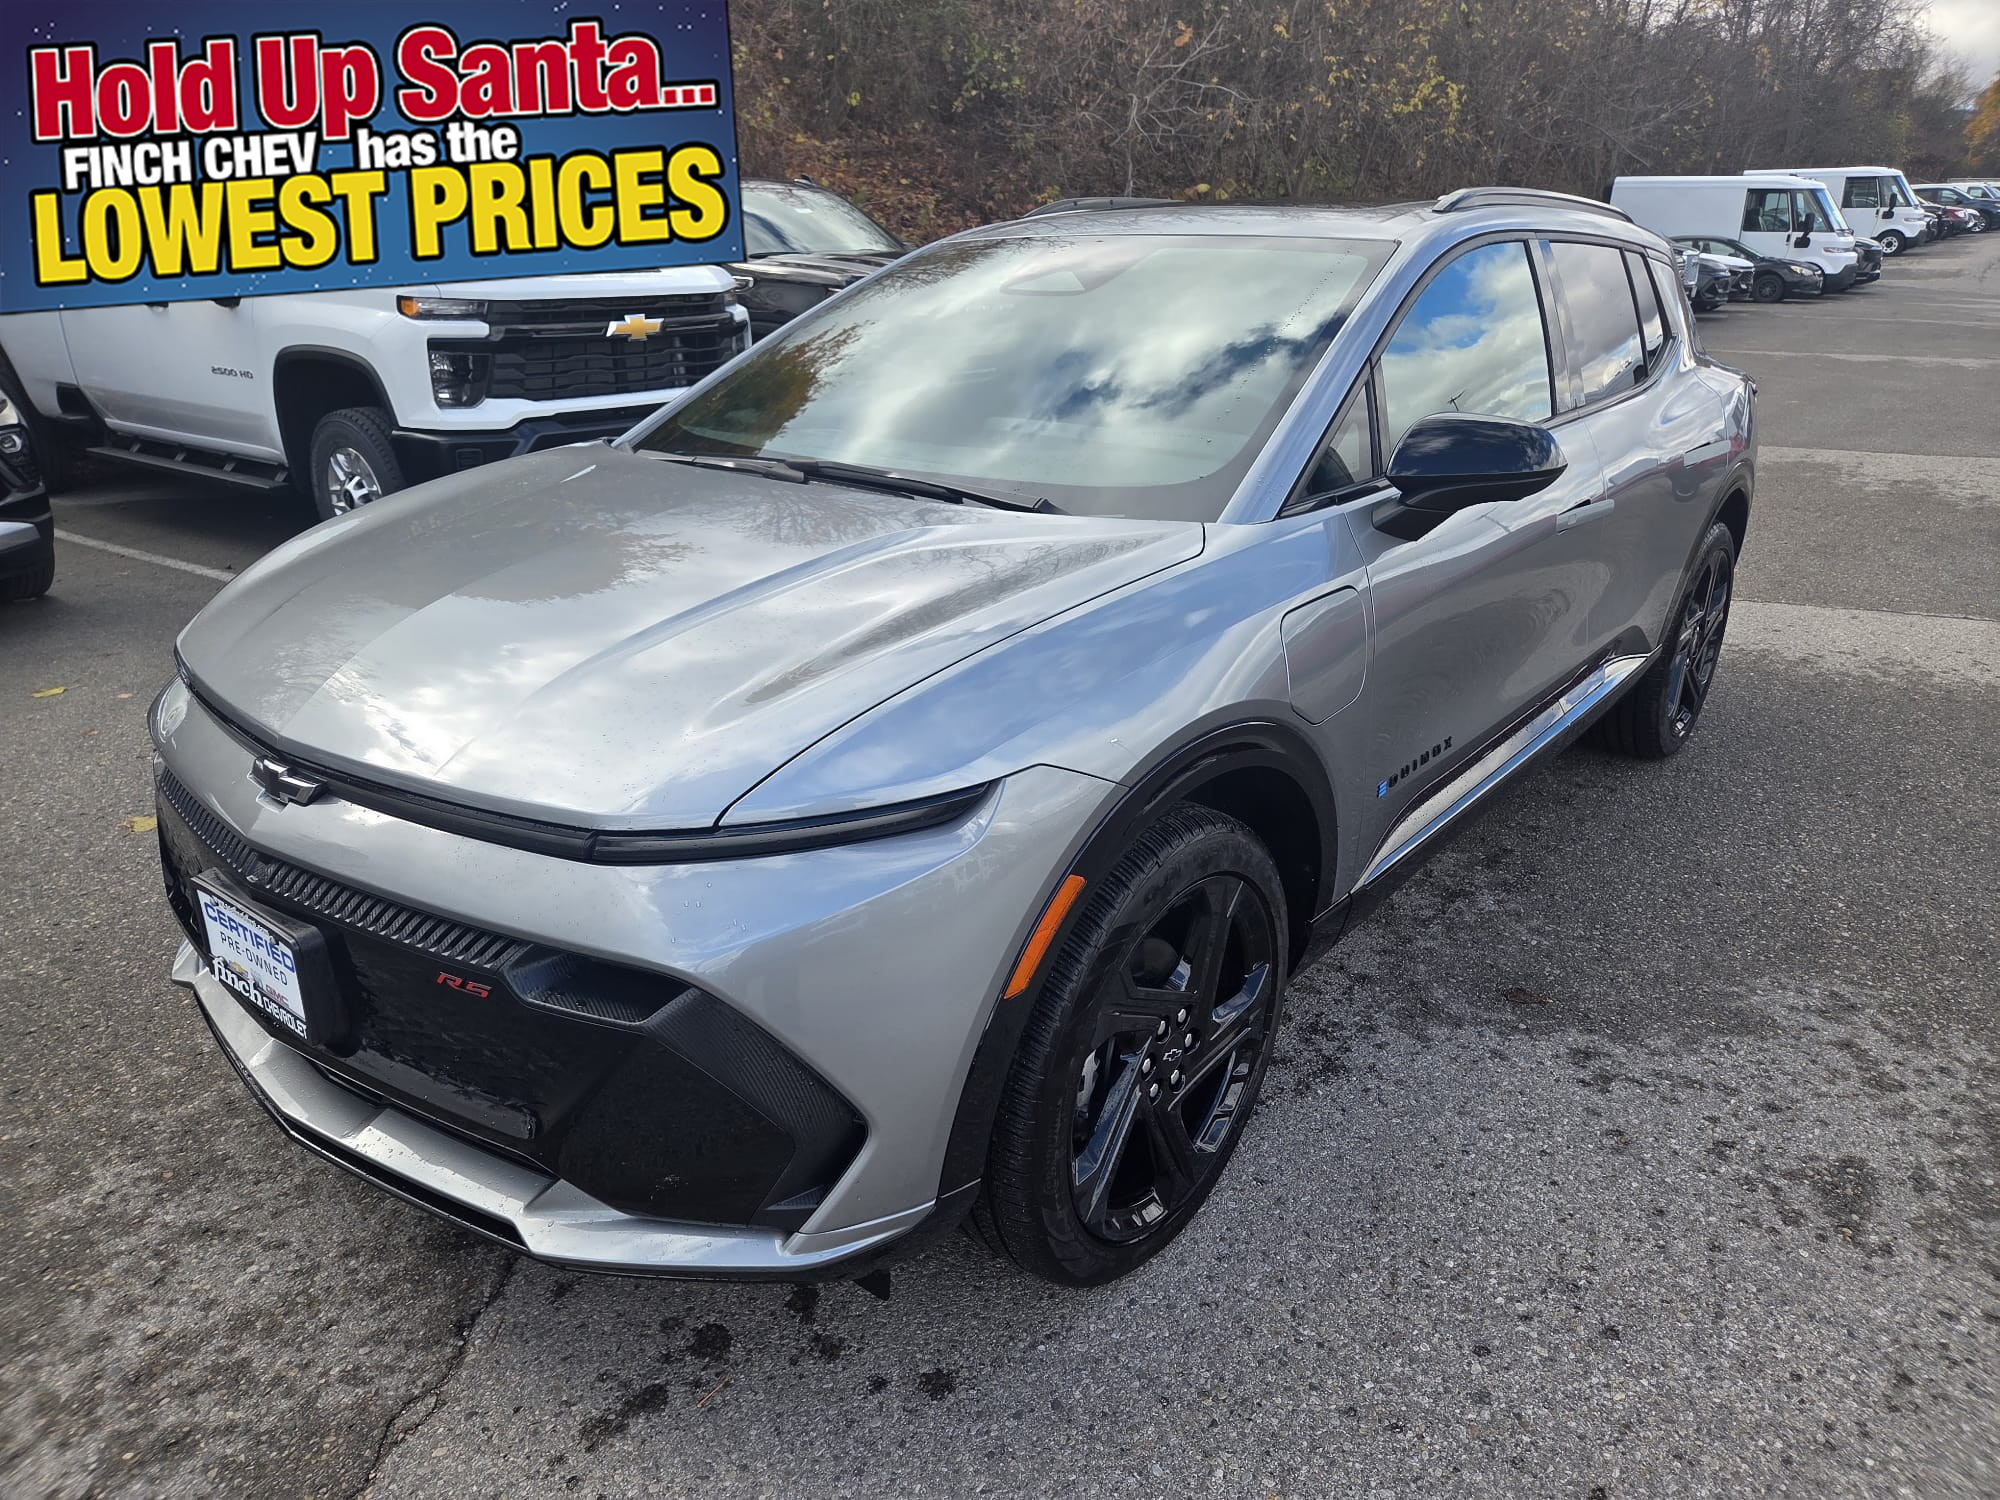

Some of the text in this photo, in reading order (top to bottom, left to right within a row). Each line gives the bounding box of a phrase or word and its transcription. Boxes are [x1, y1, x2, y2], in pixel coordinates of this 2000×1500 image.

[204, 902, 295, 973] CERTIFIED
[220, 931, 288, 986] PRE-OWNED
[211, 957, 264, 1008] finch
[437, 971, 493, 998] RS
